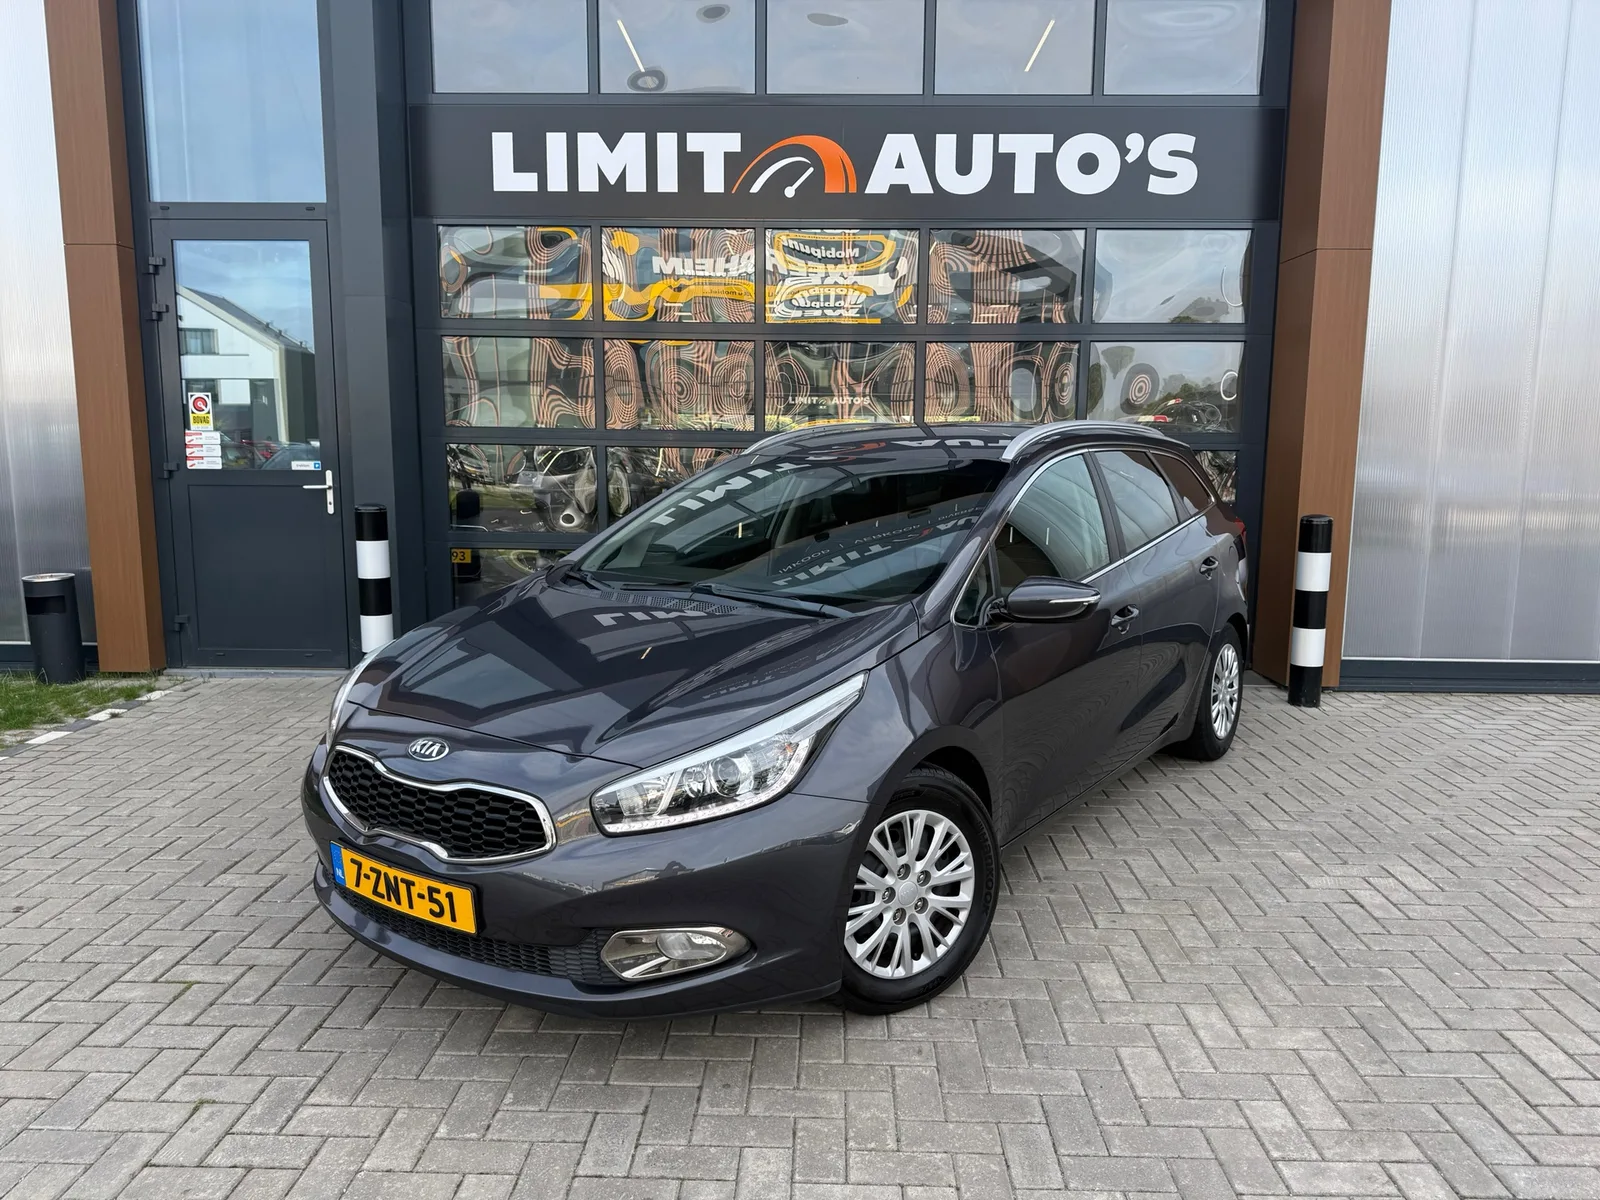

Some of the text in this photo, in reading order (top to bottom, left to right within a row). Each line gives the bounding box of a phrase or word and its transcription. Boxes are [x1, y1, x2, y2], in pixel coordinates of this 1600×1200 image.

[491, 131, 1199, 195] LIMIT AUTO'S
[192, 415, 210, 424] BOVAG
[411, 741, 442, 757] KIA
[336, 868, 345, 880] NL
[350, 858, 457, 922] 7-ZNT-51
